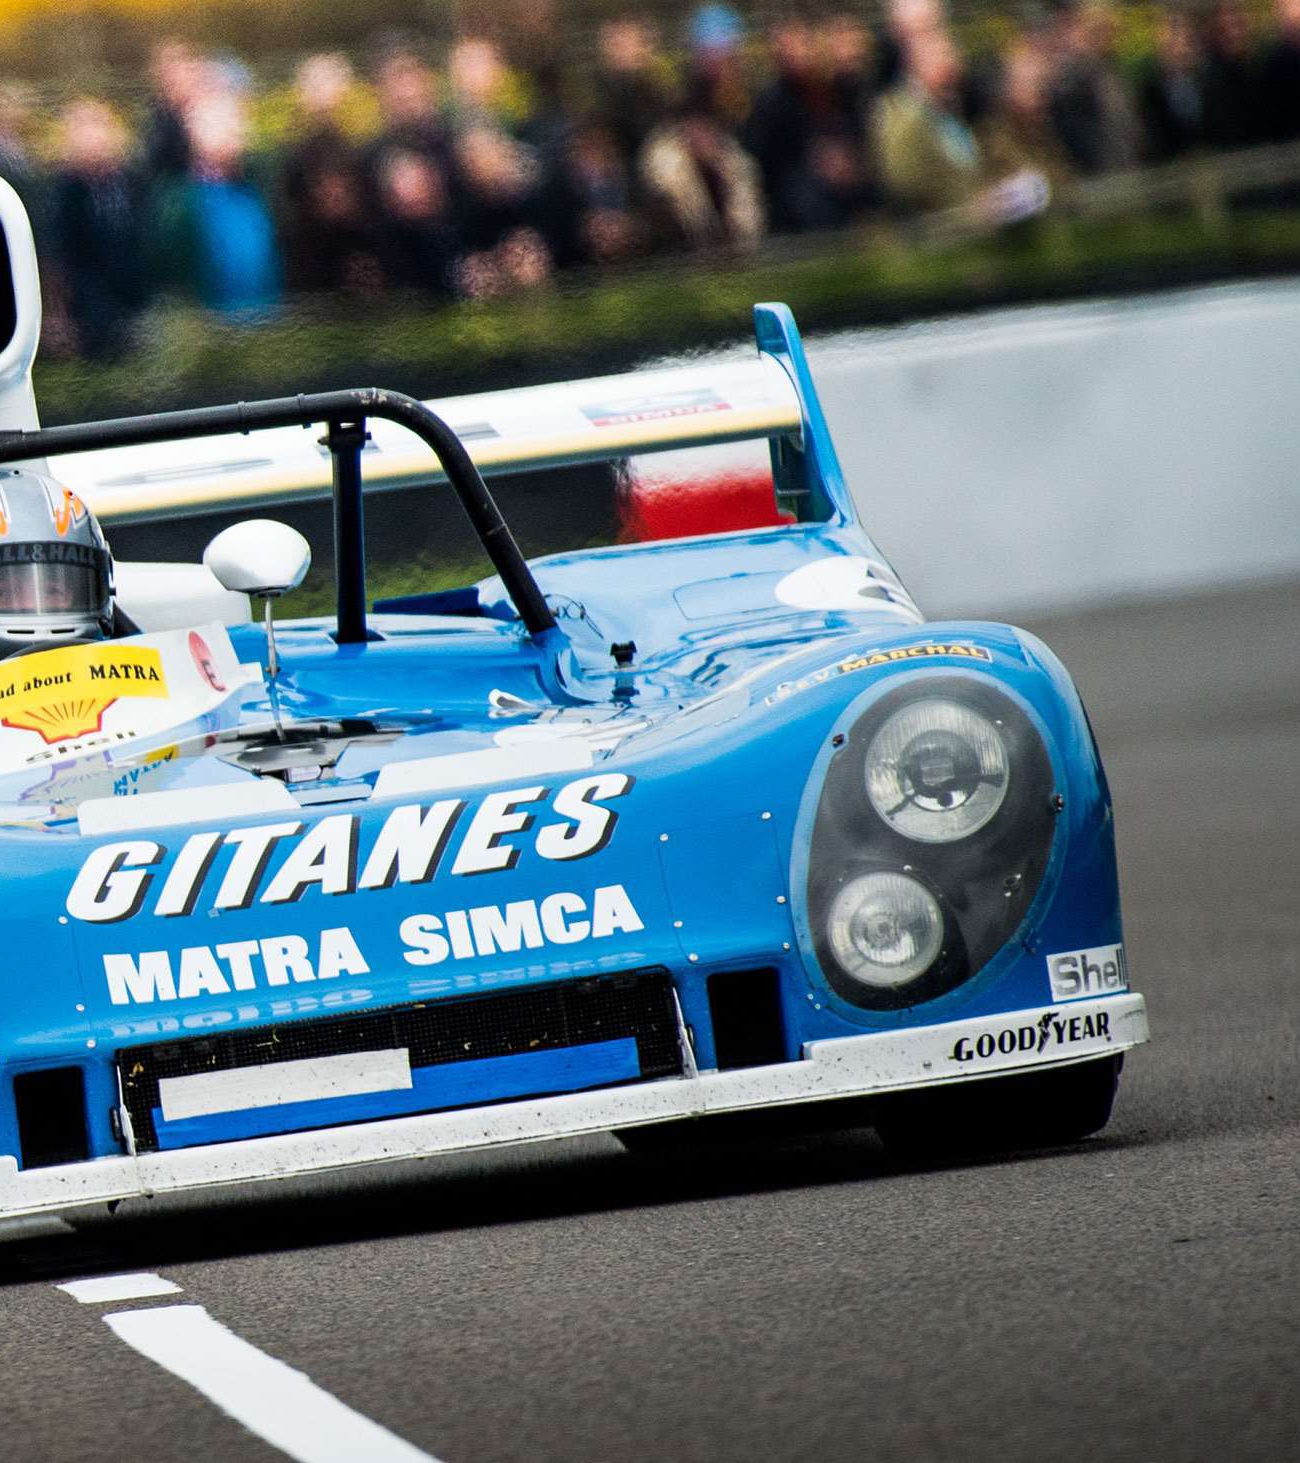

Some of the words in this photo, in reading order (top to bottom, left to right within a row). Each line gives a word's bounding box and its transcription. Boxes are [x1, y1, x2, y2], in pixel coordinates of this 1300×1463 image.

[23, 671, 73, 693] about
[89, 663, 161, 682] MATRA
[841, 645, 985, 674] MARCHAL
[65, 772, 637, 925] GITANES
[102, 926, 371, 1006] MATRA
[399, 883, 645, 967] SIMCA
[1051, 947, 1128, 997] Shell
